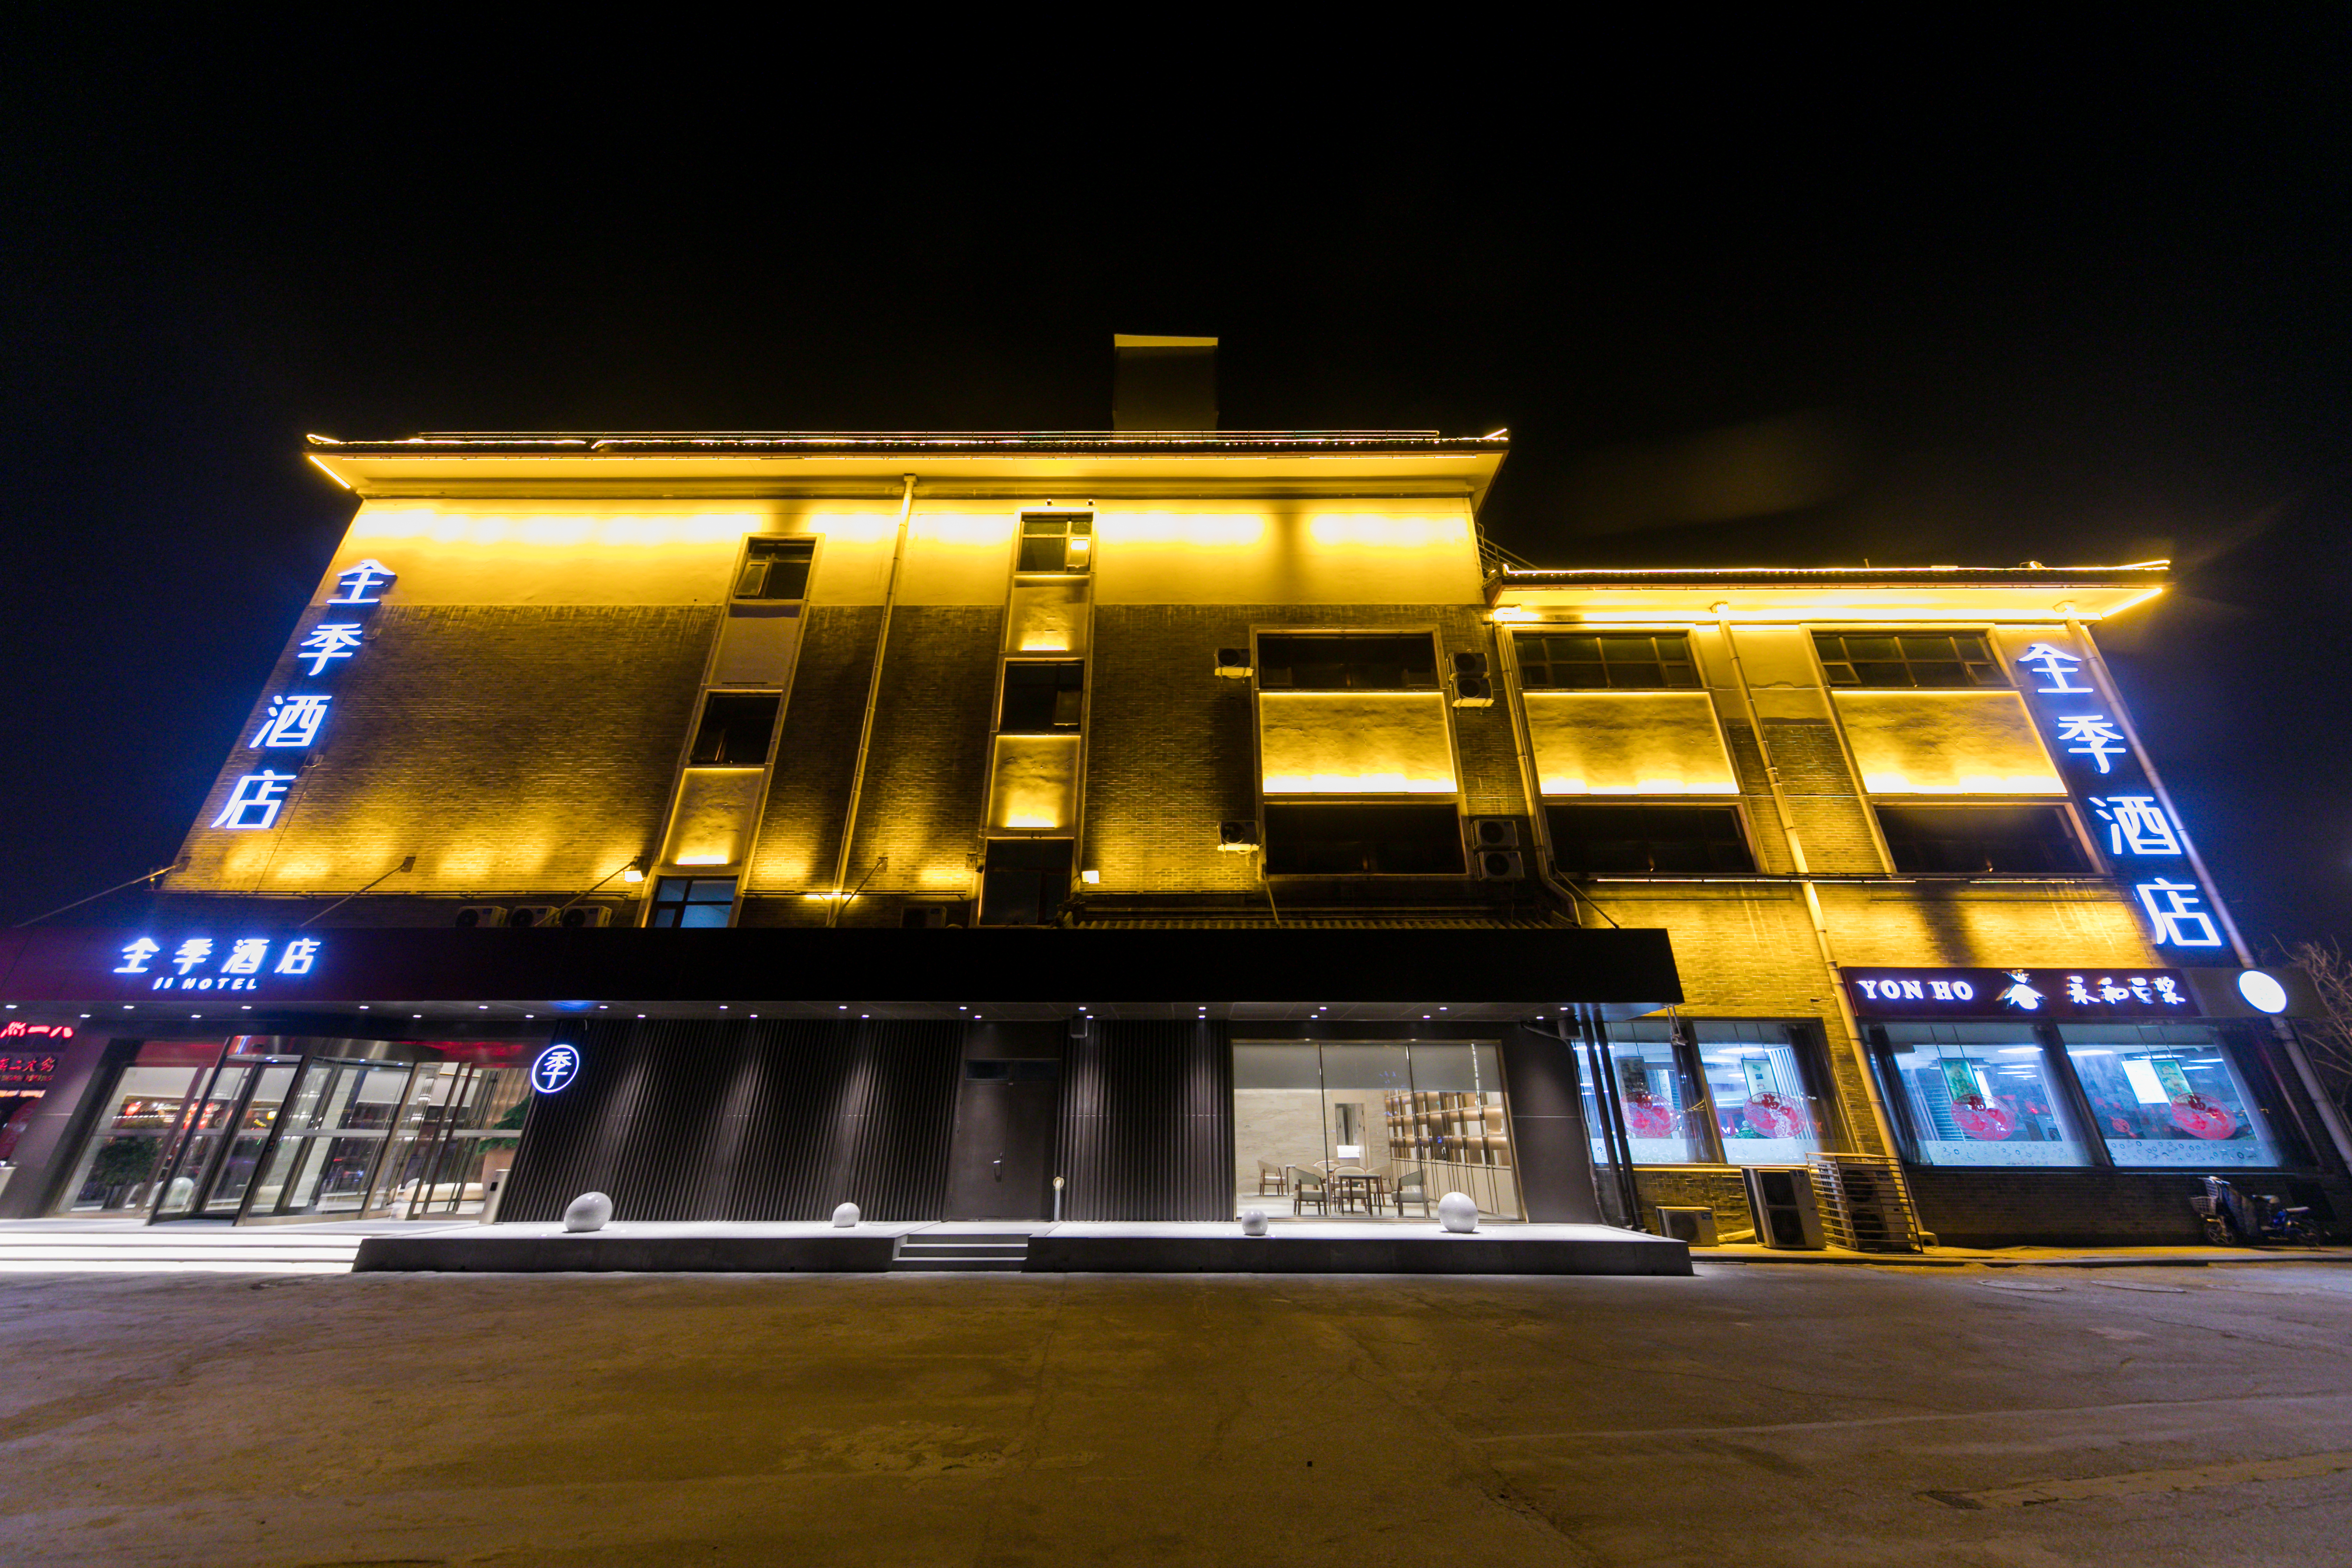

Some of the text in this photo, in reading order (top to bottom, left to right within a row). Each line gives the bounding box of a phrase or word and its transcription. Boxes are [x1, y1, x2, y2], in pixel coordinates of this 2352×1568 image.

[210, 559, 396, 830] 全季酒店
[2017, 643, 2222, 946] 全季酒店
[113, 938, 322, 974] 全季酒店
[182, 978, 257, 990] HOTEL
[1856, 980, 1974, 1001] YON HO
[541, 1051, 572, 1089] 季
